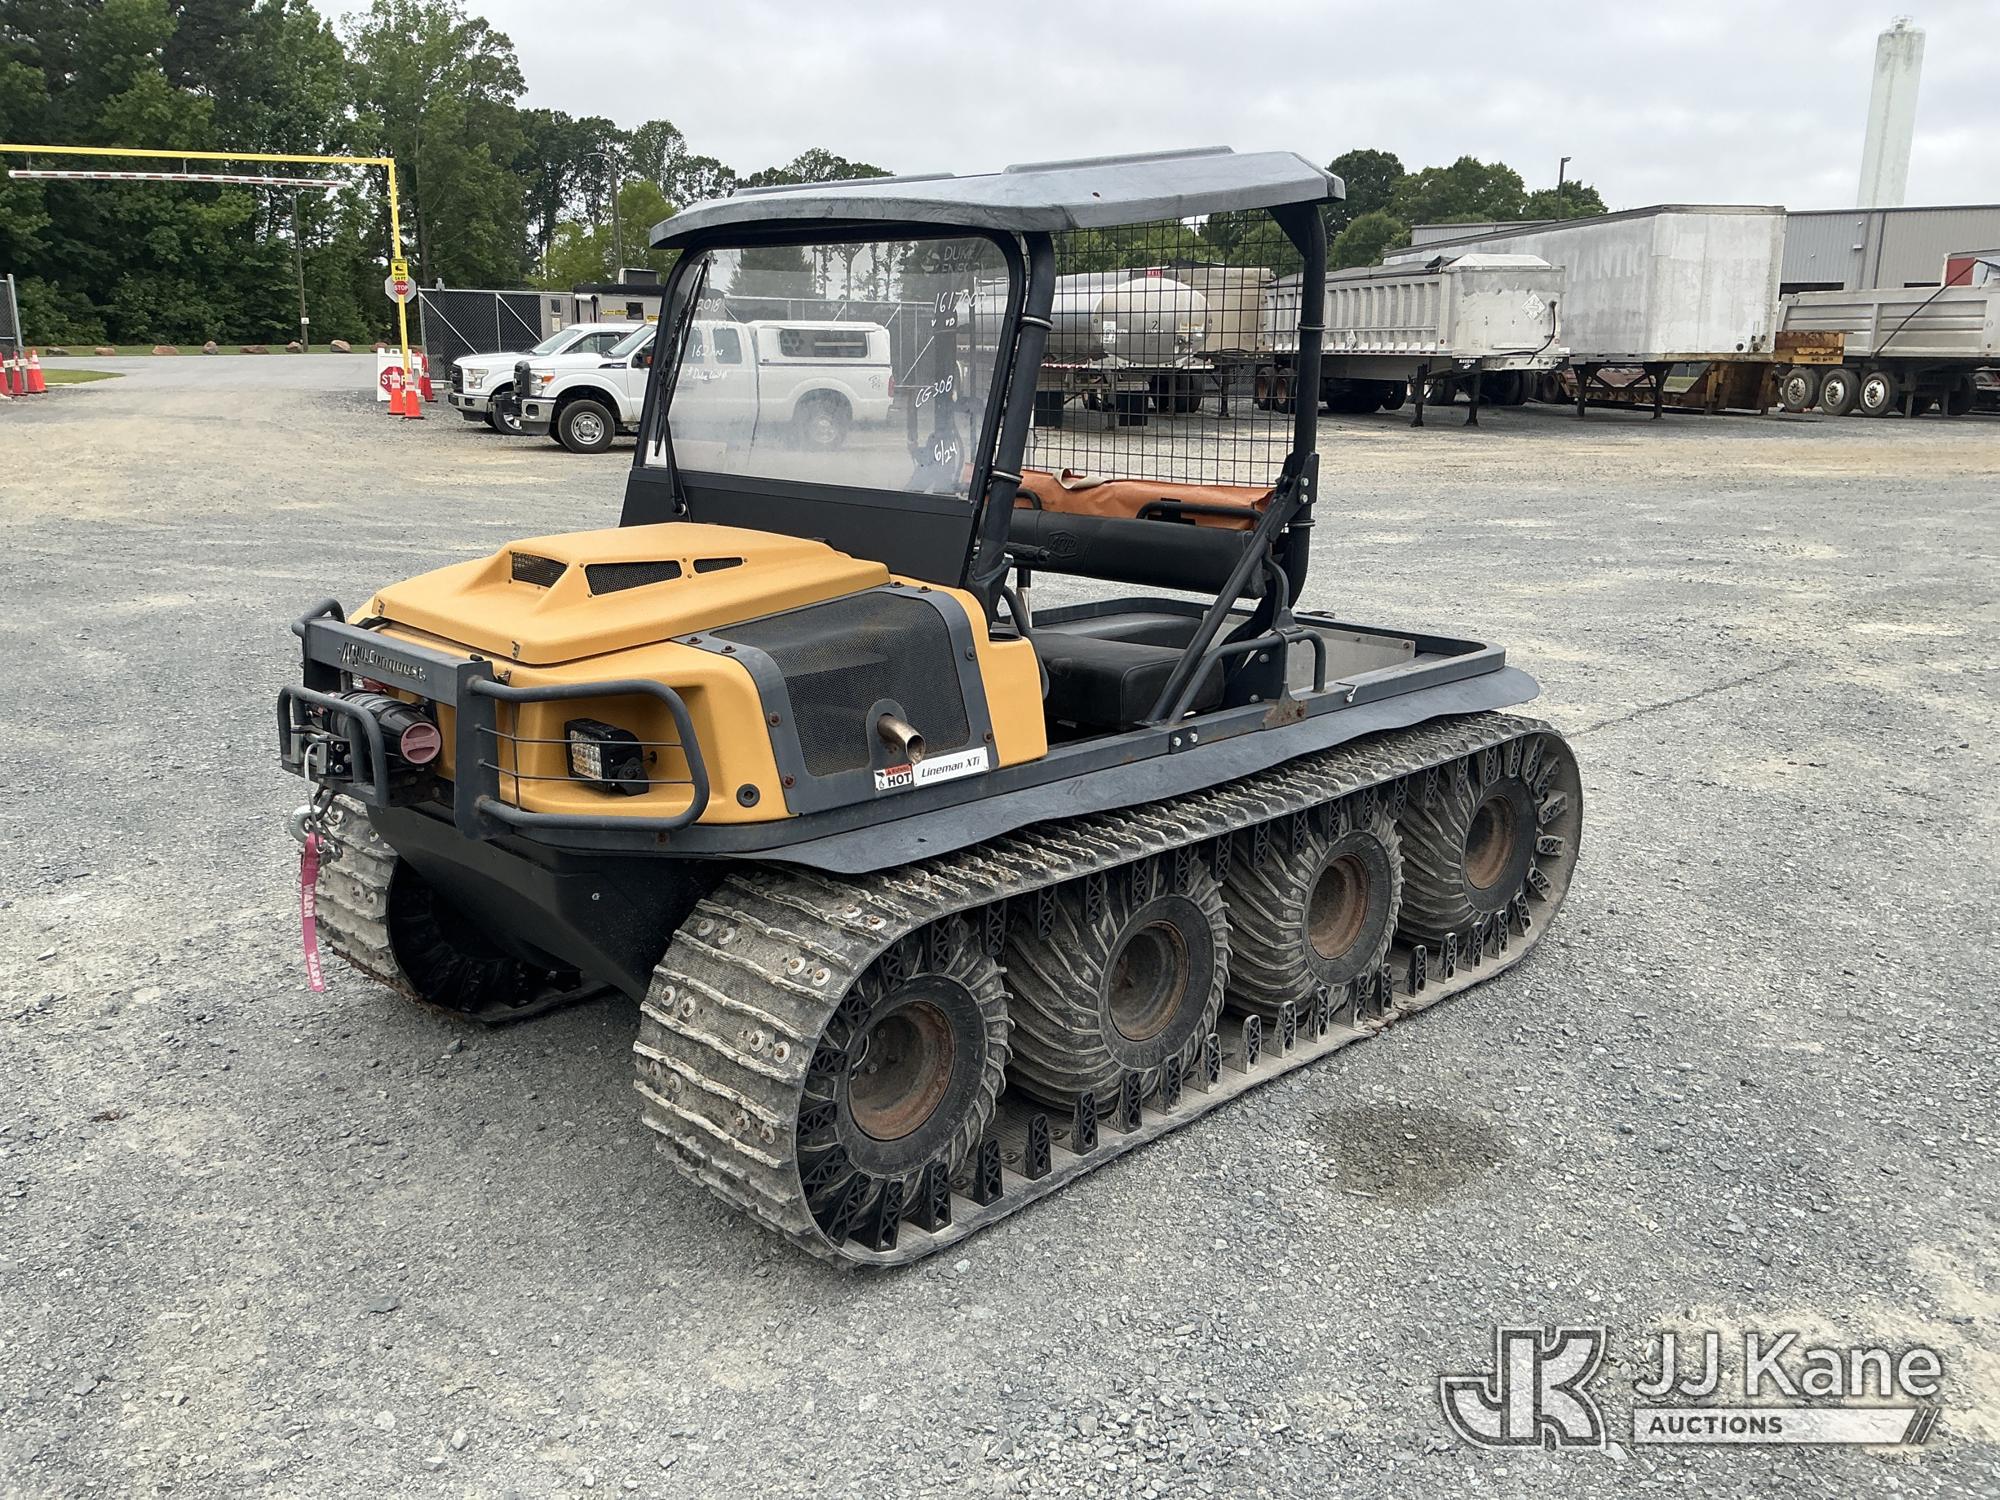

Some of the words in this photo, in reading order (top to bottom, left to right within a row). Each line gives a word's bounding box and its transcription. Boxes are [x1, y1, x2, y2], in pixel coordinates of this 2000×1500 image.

[695, 298, 721, 312] 2018
[381, 374, 407, 385] STP
[934, 440, 958, 466] 6/24
[921, 761, 963, 778] Lineman
[965, 755, 981, 769] XTi
[888, 773, 910, 787] HOT
[303, 883, 314, 918] WARN
[308, 950, 322, 987] WARN
